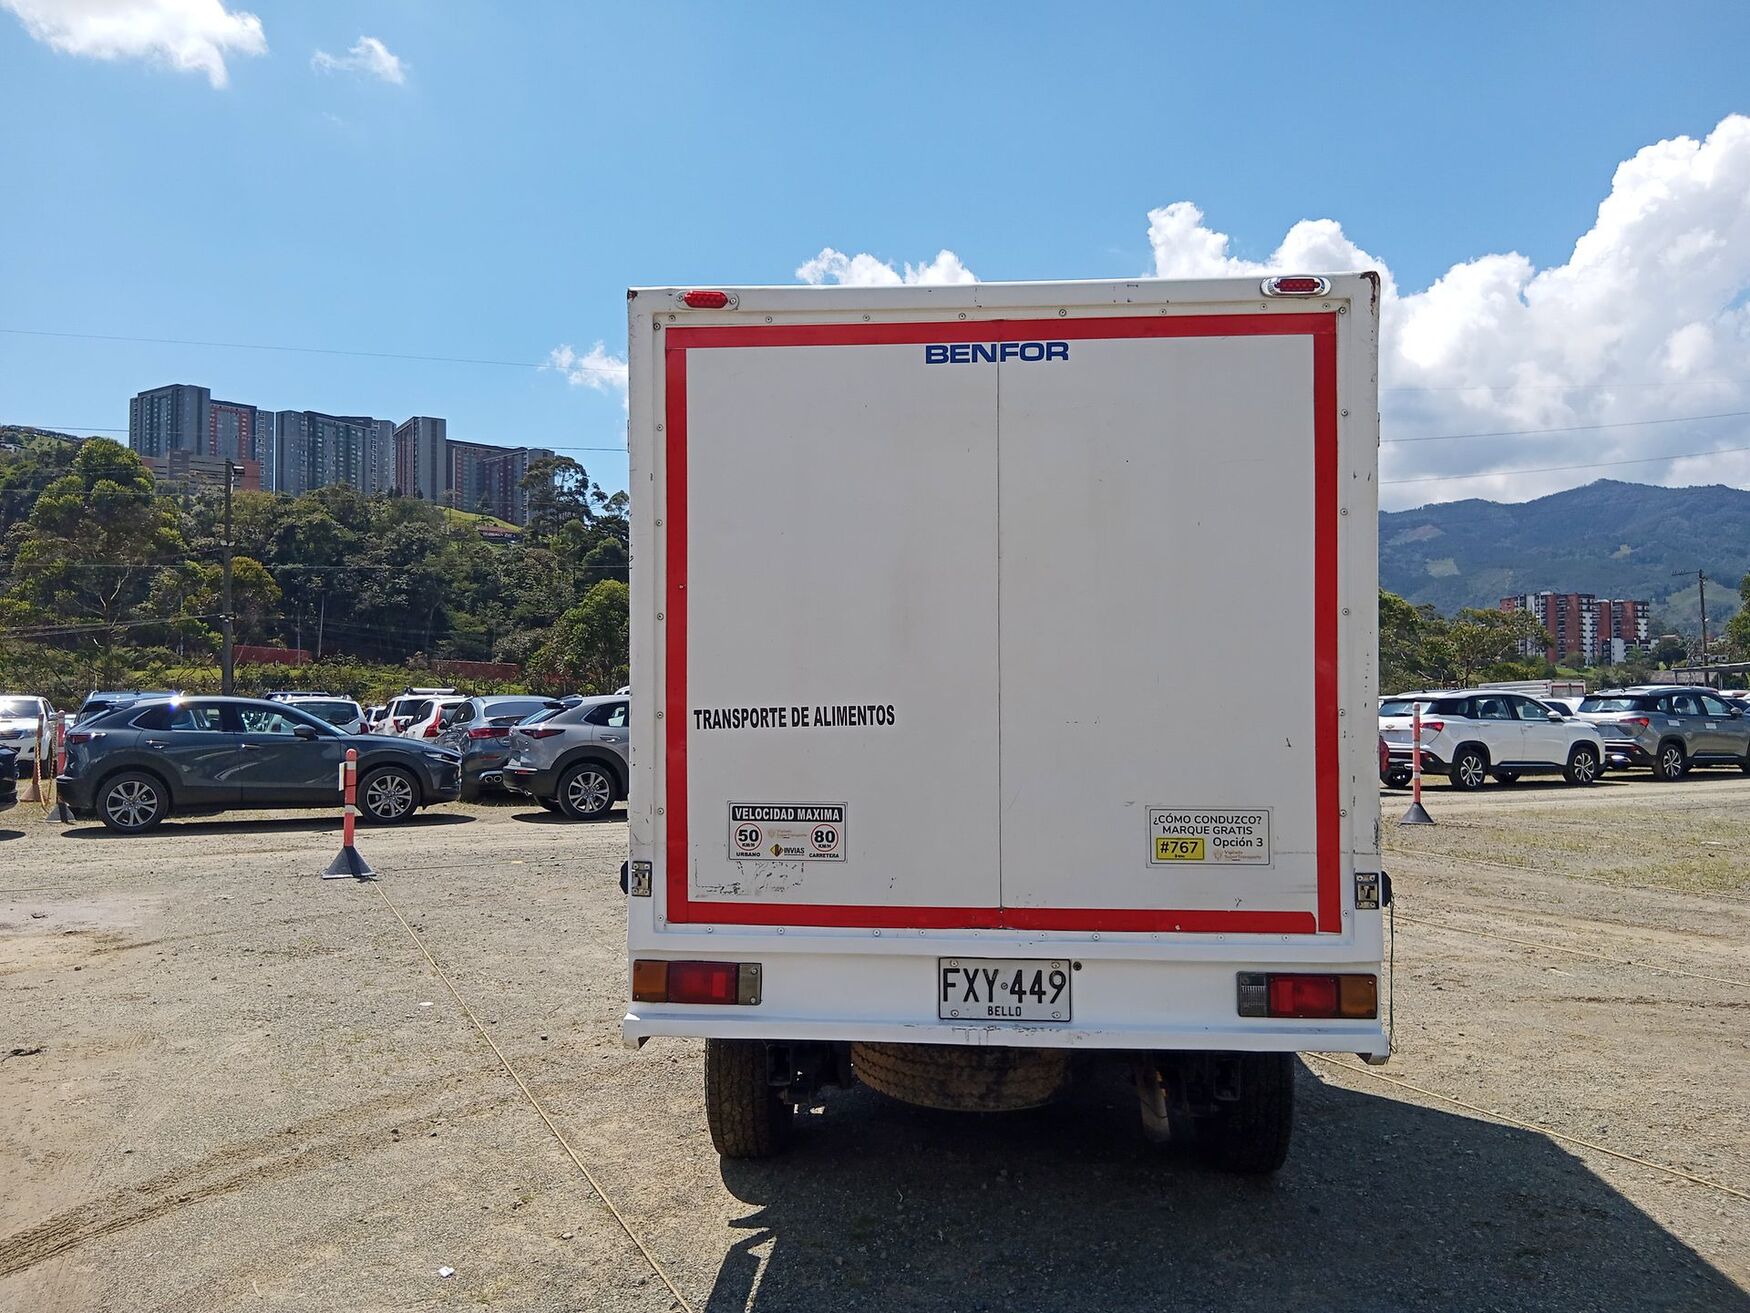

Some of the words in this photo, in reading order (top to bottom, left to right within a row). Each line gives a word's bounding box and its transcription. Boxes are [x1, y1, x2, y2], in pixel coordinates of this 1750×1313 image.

[925, 341, 1069, 364] BENFOR
[693, 707, 787, 730] TRANSPORTE
[791, 706, 810, 727] DE
[813, 704, 895, 727] ALIMENTOS
[735, 807, 795, 820] VELOCIDAD
[797, 808, 840, 821] MAXIMA
[1153, 813, 1192, 825] ¿CÓMO
[1193, 815, 1262, 825] CONDUZCO?
[738, 829, 759, 842] 50
[814, 830, 836, 843] 80
[1162, 825, 1210, 836] MARQUE
[1212, 826, 1253, 835] GRATIS
[1160, 841, 1198, 854] #767
[1212, 837, 1253, 848] Opción
[1256, 837, 1264, 847] 3
[987, 1005, 1022, 1017] BELLO
